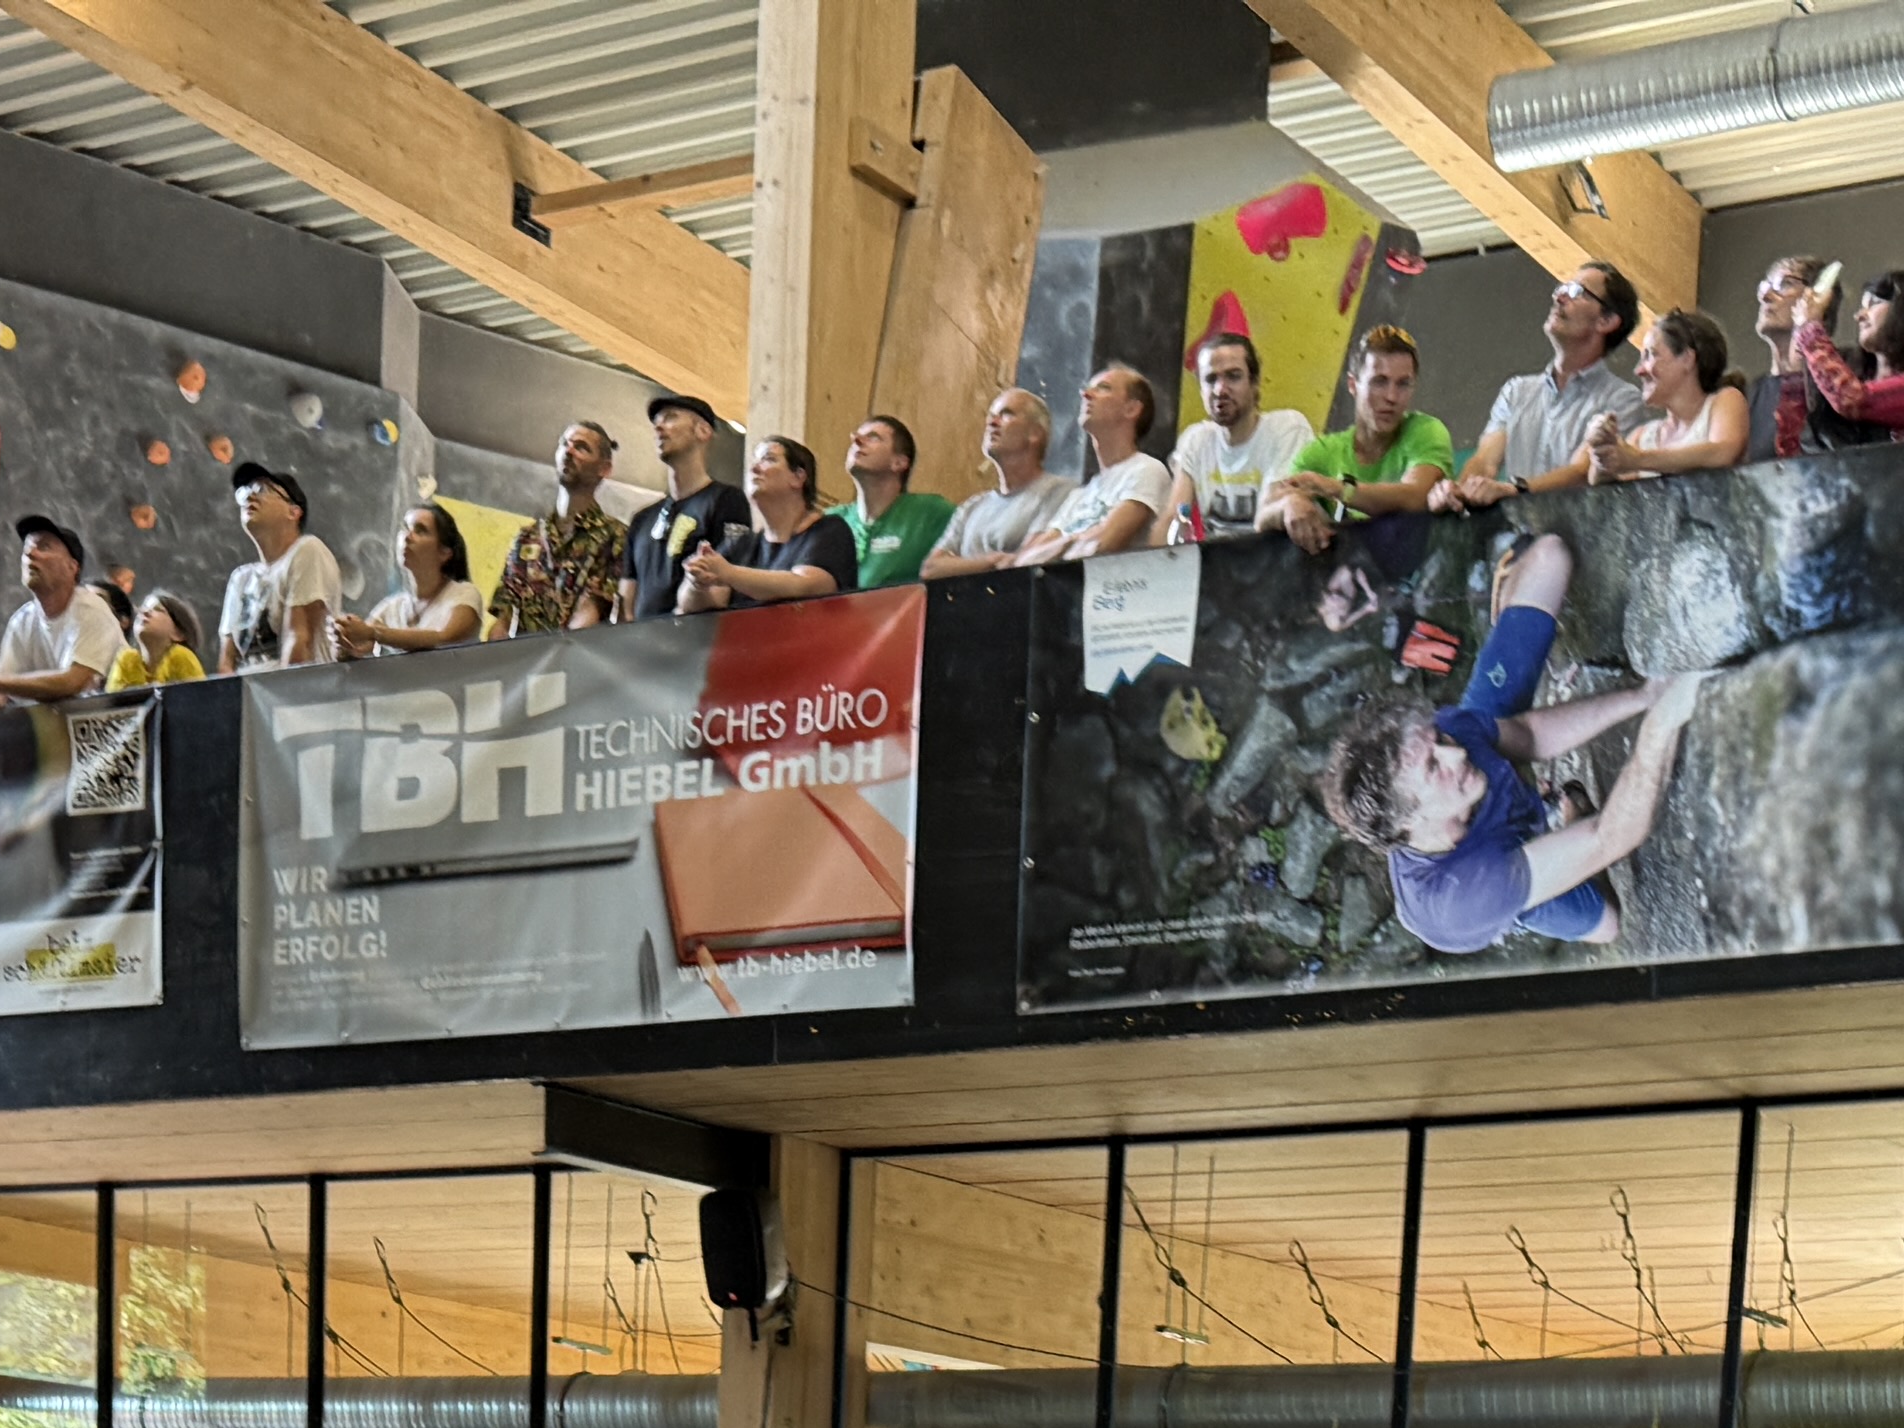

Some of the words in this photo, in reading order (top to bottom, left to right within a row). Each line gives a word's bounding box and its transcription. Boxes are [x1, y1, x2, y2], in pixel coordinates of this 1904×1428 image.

[575, 701, 786, 763] TECHNISCHES
[795, 682, 889, 737] BÜRO
[272, 671, 566, 841] TBH
[576, 758, 724, 813] HIEBEL
[738, 738, 886, 793] GmbH
[274, 866, 327, 896] WIR
[274, 896, 381, 931] PLANEN
[273, 930, 388, 966] ERFOLG!
